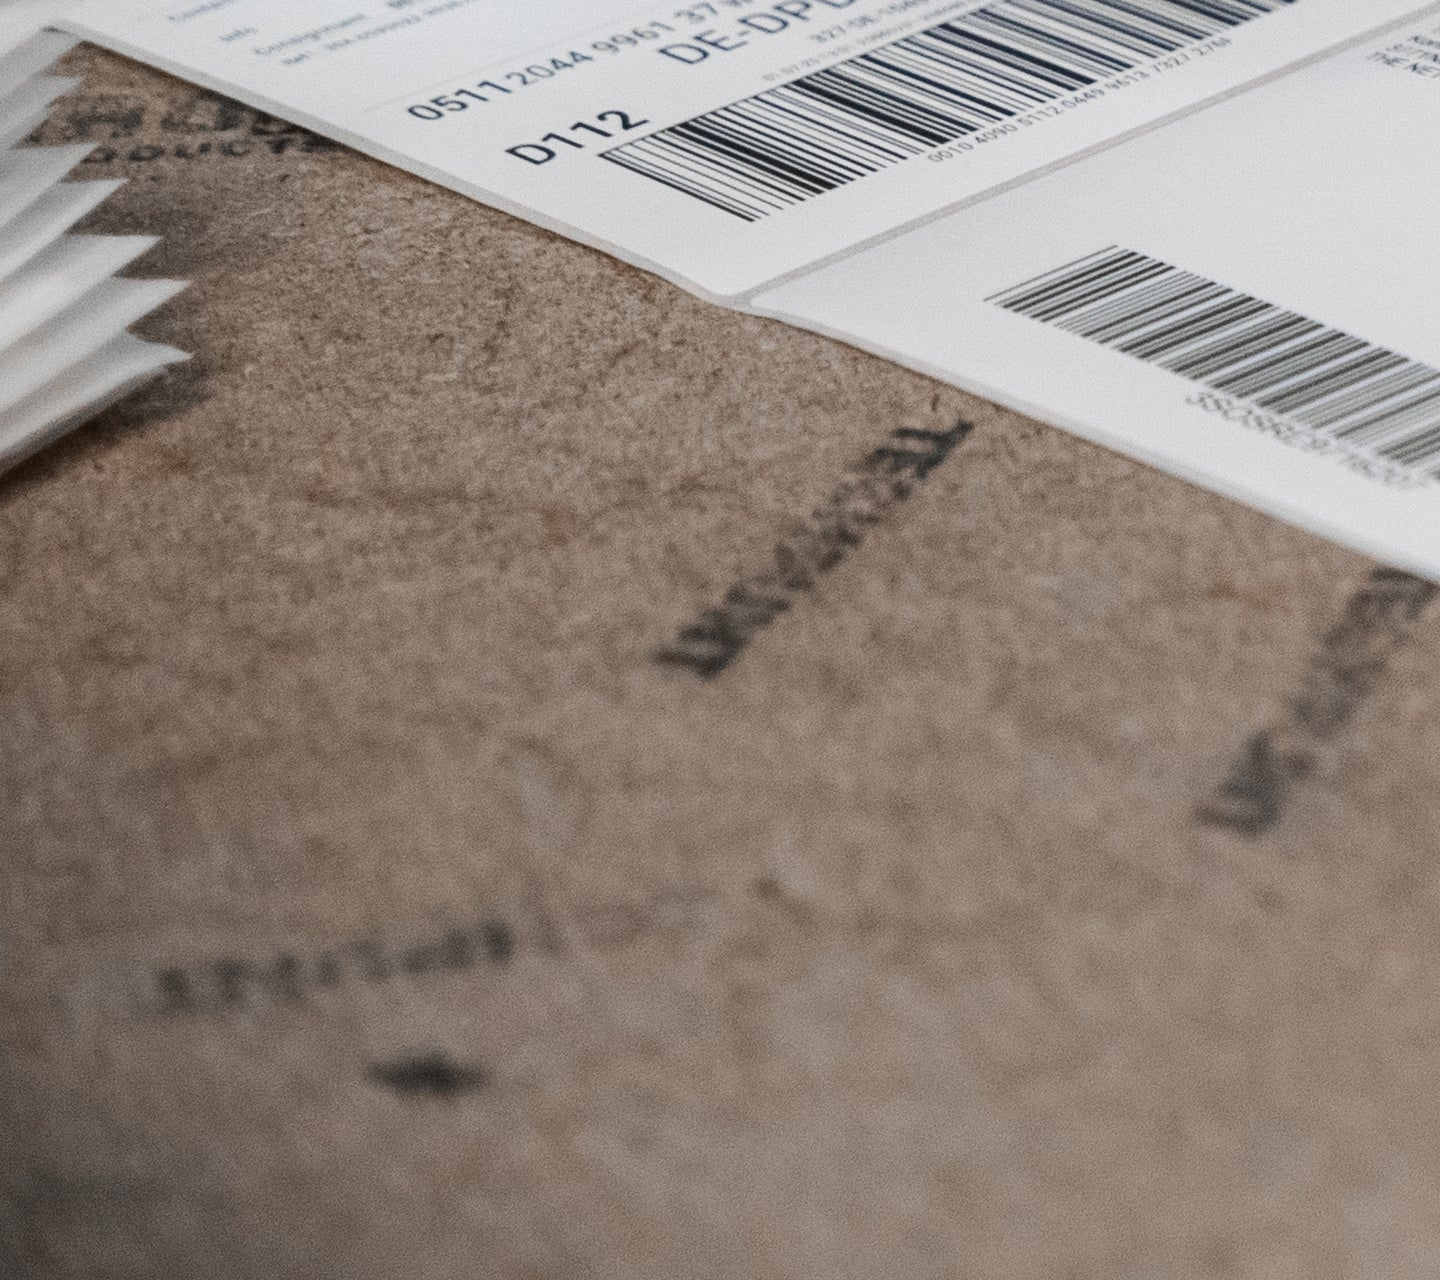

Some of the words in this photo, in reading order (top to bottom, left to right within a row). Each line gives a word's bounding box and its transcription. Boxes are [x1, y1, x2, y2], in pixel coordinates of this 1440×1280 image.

[406, 80, 511, 120] 0511
[504, 50, 593, 86] 2044
[1367, 47, 1408, 67] THE
[505, 109, 648, 165] D112
